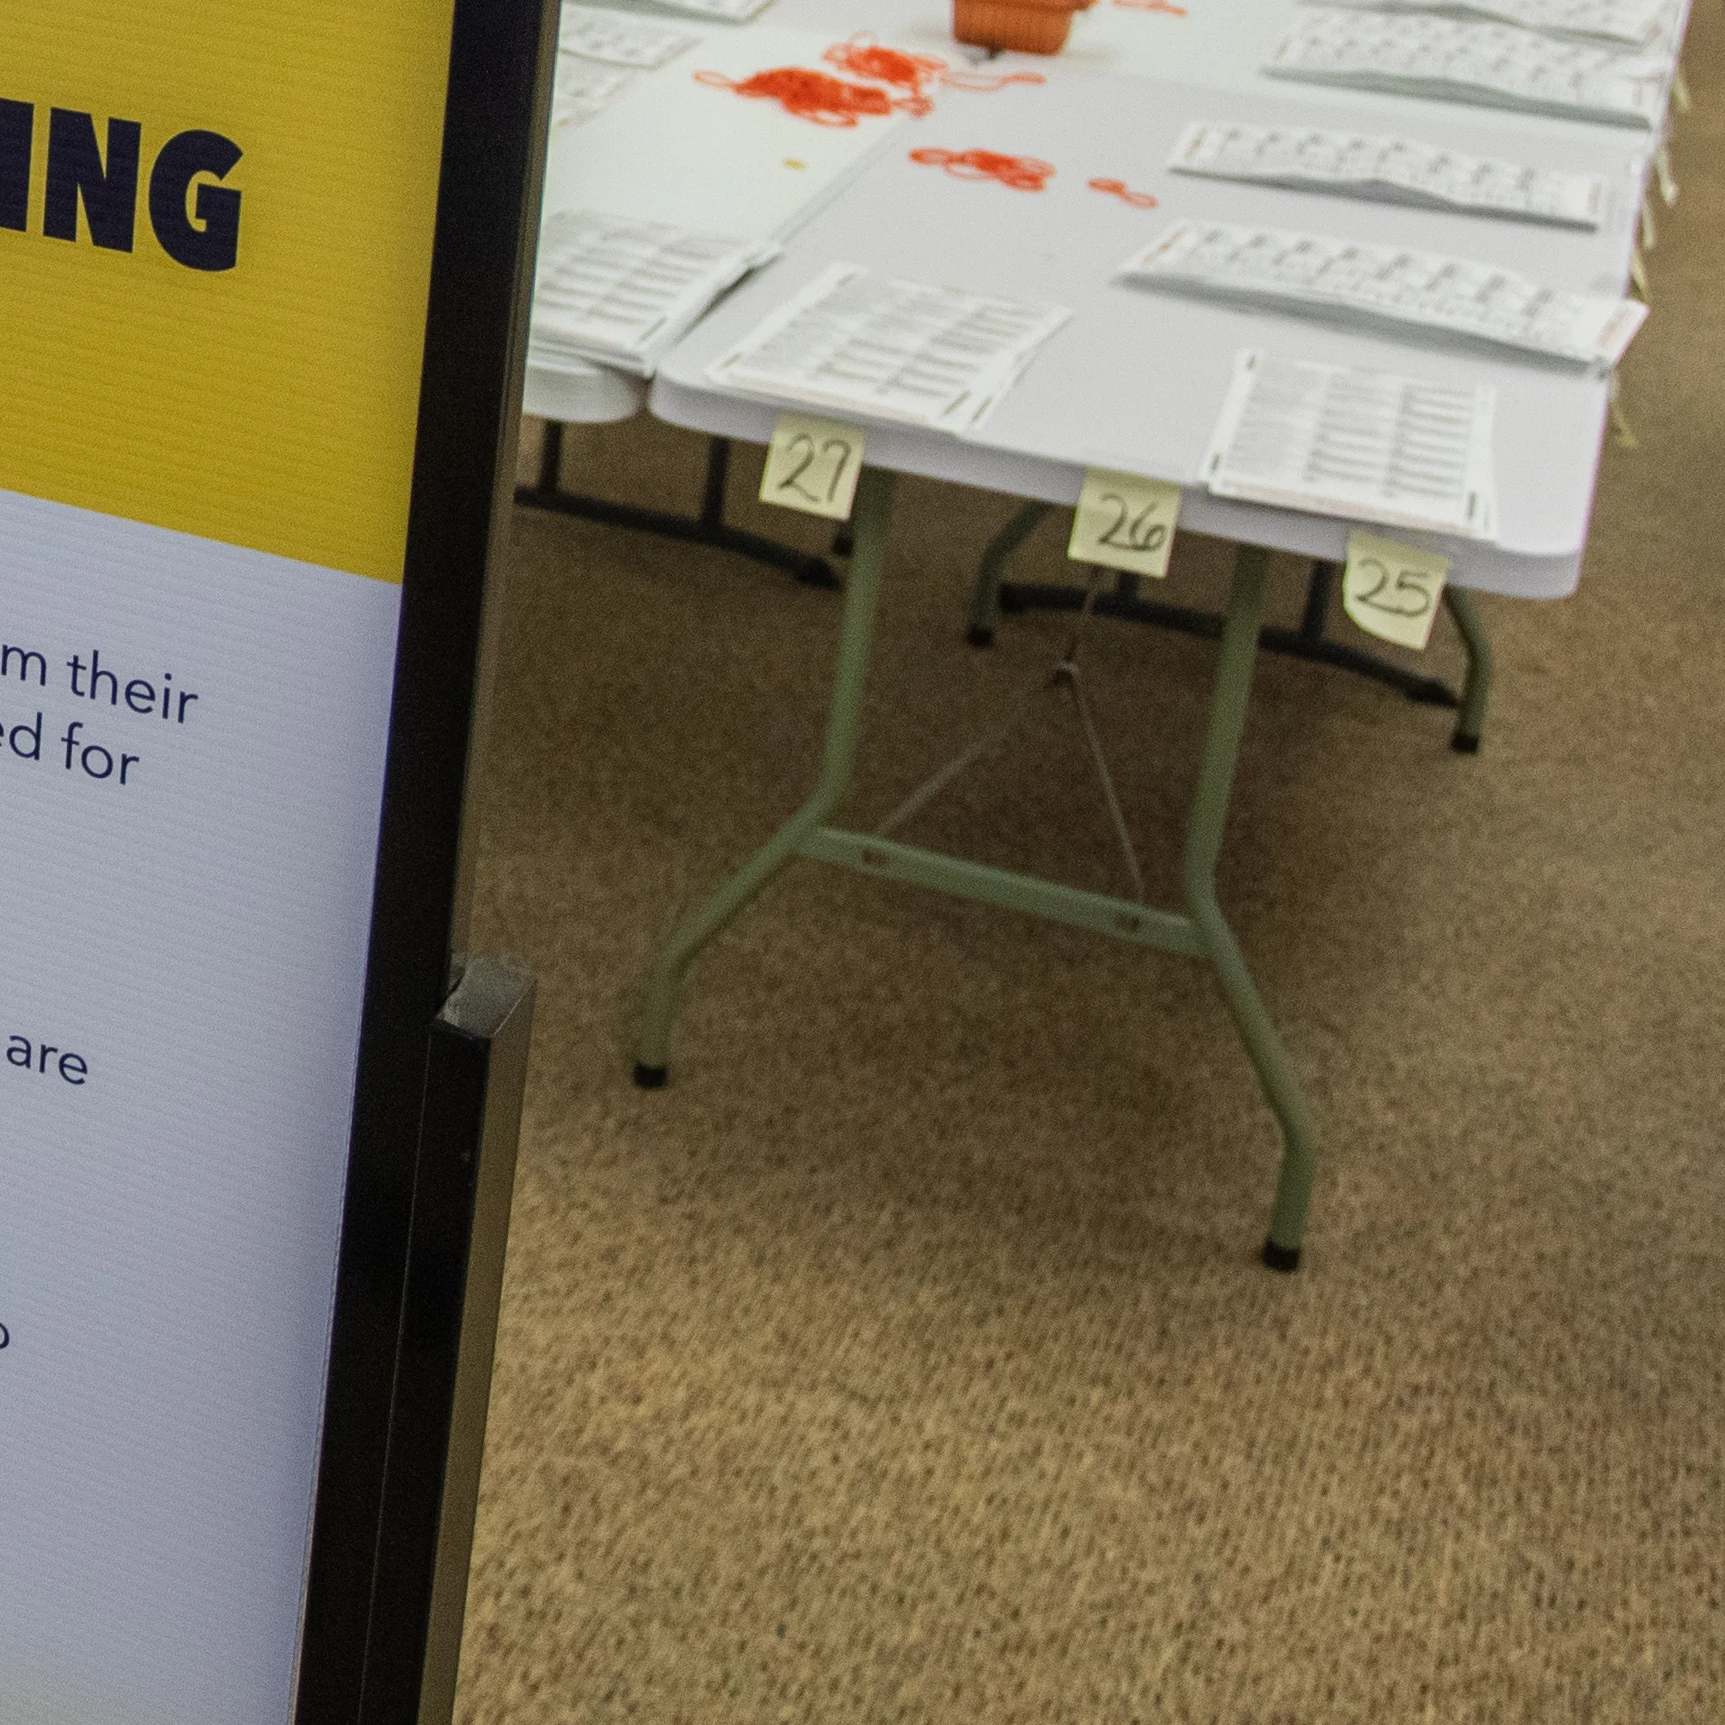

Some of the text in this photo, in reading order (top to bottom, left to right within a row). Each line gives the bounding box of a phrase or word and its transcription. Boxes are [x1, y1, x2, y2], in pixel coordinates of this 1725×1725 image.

[778, 432, 853, 502] 27
[1098, 492, 1166, 551] 26
[1354, 557, 1433, 618] 25
[66, 648, 199, 725] their
[60, 720, 141, 786] for
[5, 1034, 89, 1086] are
